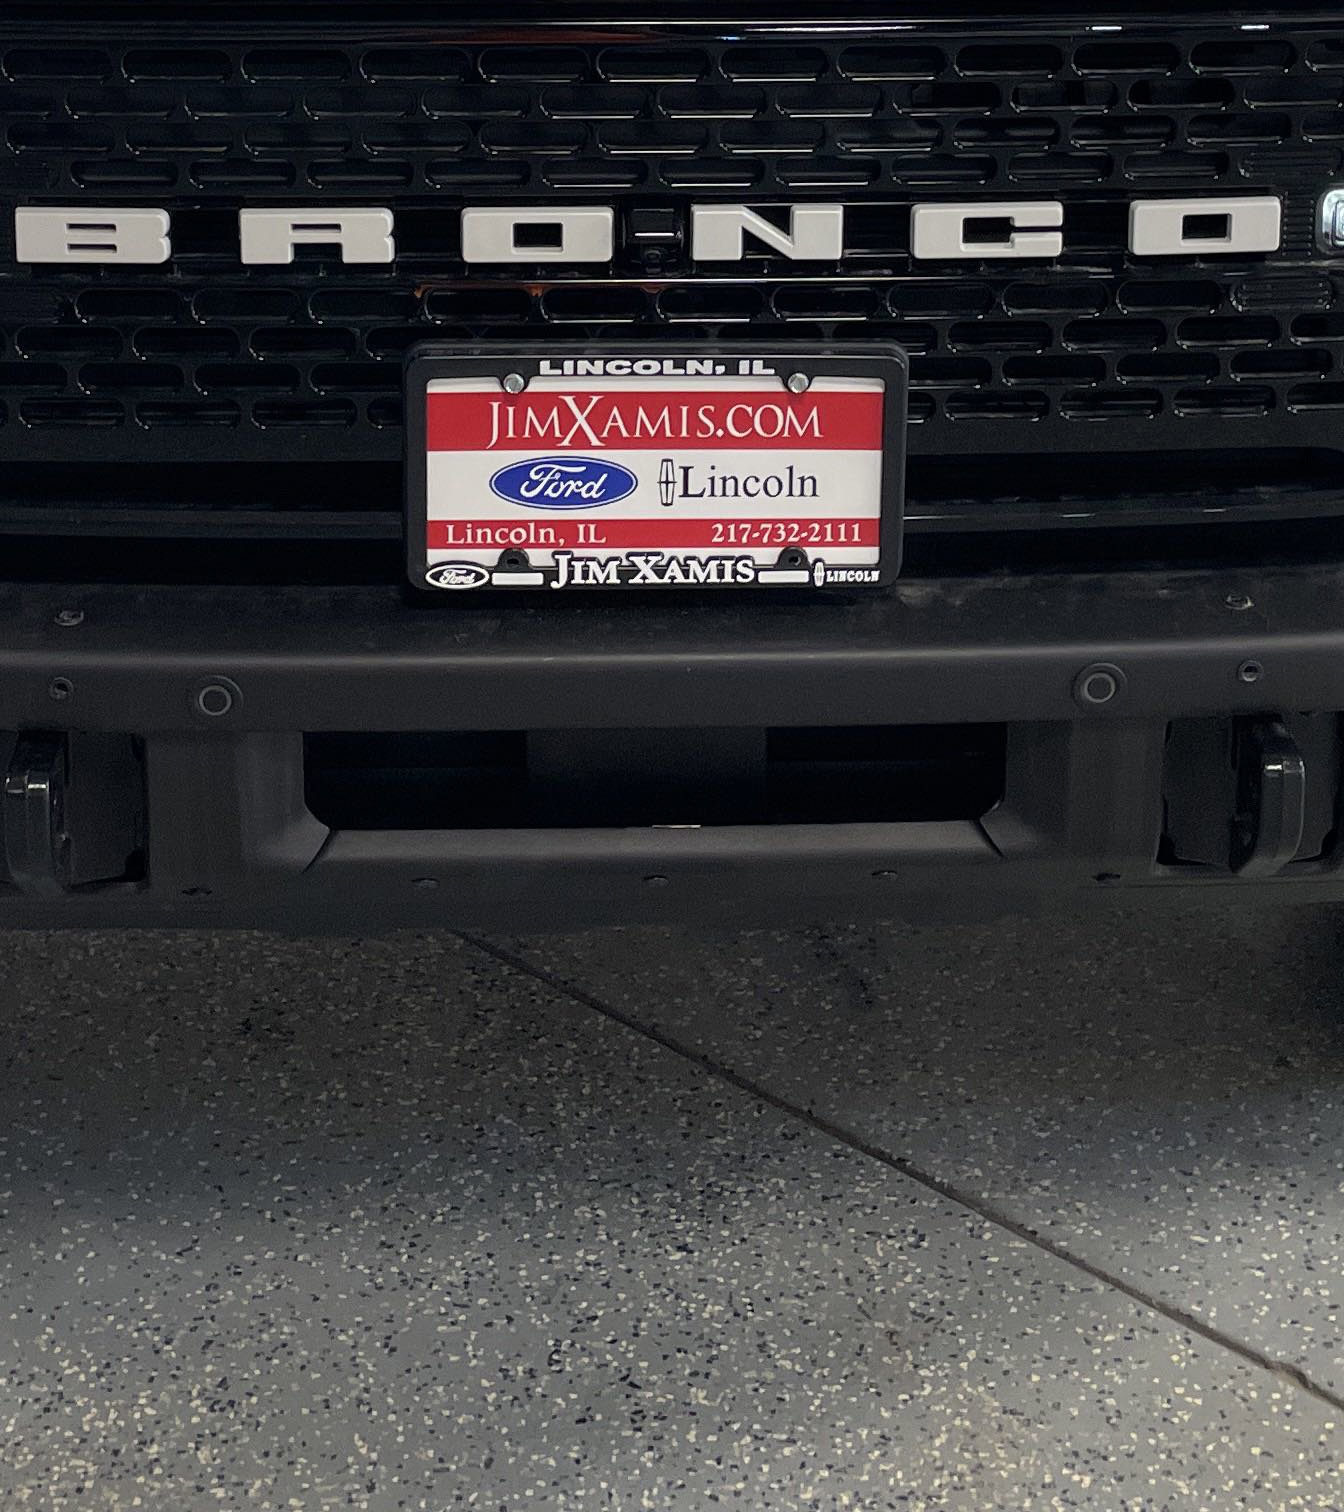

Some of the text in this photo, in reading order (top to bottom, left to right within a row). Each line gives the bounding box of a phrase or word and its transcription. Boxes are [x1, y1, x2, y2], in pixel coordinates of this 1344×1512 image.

[15, 194, 1281, 267] BRONCO
[539, 359, 775, 376] LINCOLN, IL
[520, 463, 606, 500] Ford
[678, 464, 820, 499] Lincoln
[445, 524, 606, 548] Lincoln, IL
[711, 523, 862, 544] 217-732-2111
[825, 569, 881, 584] LINCOLN
